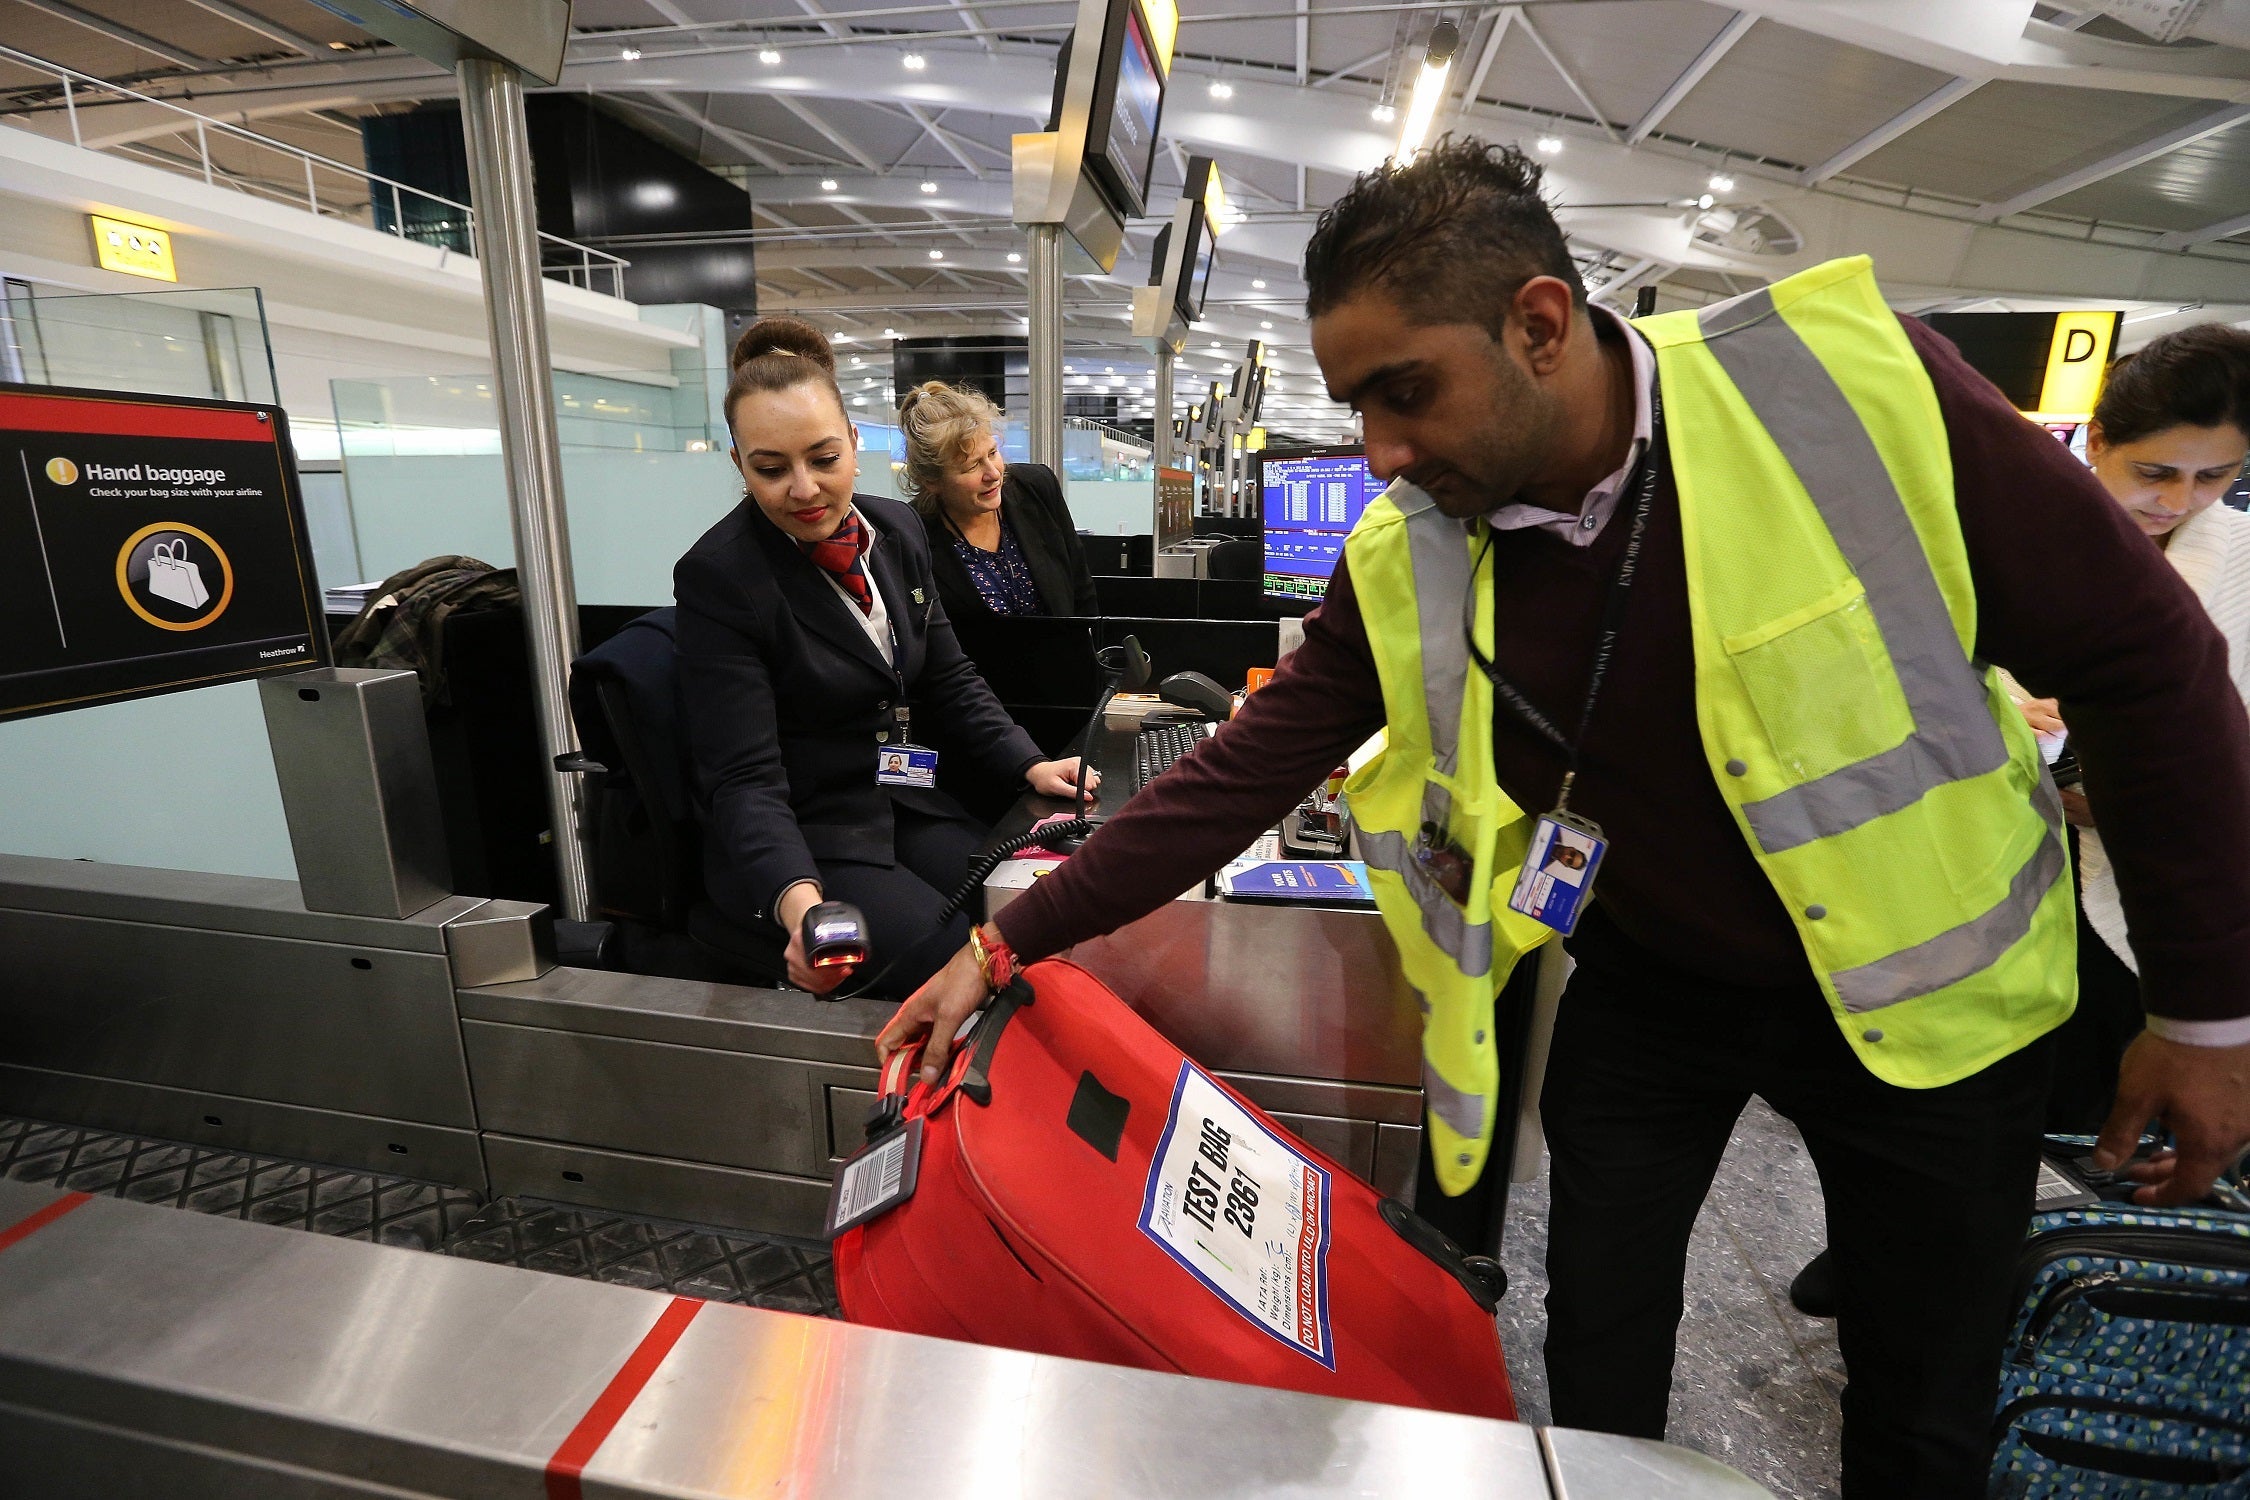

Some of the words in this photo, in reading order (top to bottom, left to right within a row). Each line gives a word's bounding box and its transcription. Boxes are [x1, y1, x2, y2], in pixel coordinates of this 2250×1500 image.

[2063, 329, 2096, 363] D
[85, 463, 142, 482] Hand
[145, 464, 226, 485] baggage
[89, 487, 122, 497] Check
[124, 489, 148, 498] your
[150, 488, 169, 498] bag
[171, 488, 190, 497] size
[191, 488, 212, 496] with
[214, 488, 235, 498] your
[236, 487, 263, 496] airline
[1638, 469, 1657, 519] ARMANI
[259, 646, 297, 658] Heathrow
[1271, 873, 1285, 887] YOUR
[1282, 869, 1299, 887] RIGHTS
[1198, 1117, 1232, 1173] BAG
[1162, 1182, 1174, 1221] AVIATION
[1182, 1160, 1222, 1232] TEST
[1223, 1165, 1261, 1239] 2361
[1306, 1169, 1316, 1213] AIRCRAFT
[1306, 1212, 1316, 1226] OR
[1302, 1226, 1316, 1249] ULD
[1301, 1249, 1312, 1275] INTO
[1259, 1266, 1269, 1287] Ref:
[1257, 1286, 1268, 1312] IATA
[1282, 1275, 1292, 1330] Dimensions
[1301, 1275, 1312, 1305] LOAD
[1269, 1286, 1282, 1321] Weight
[1301, 1306, 1313, 1328] NOT
[1302, 1328, 1315, 1347] DO
